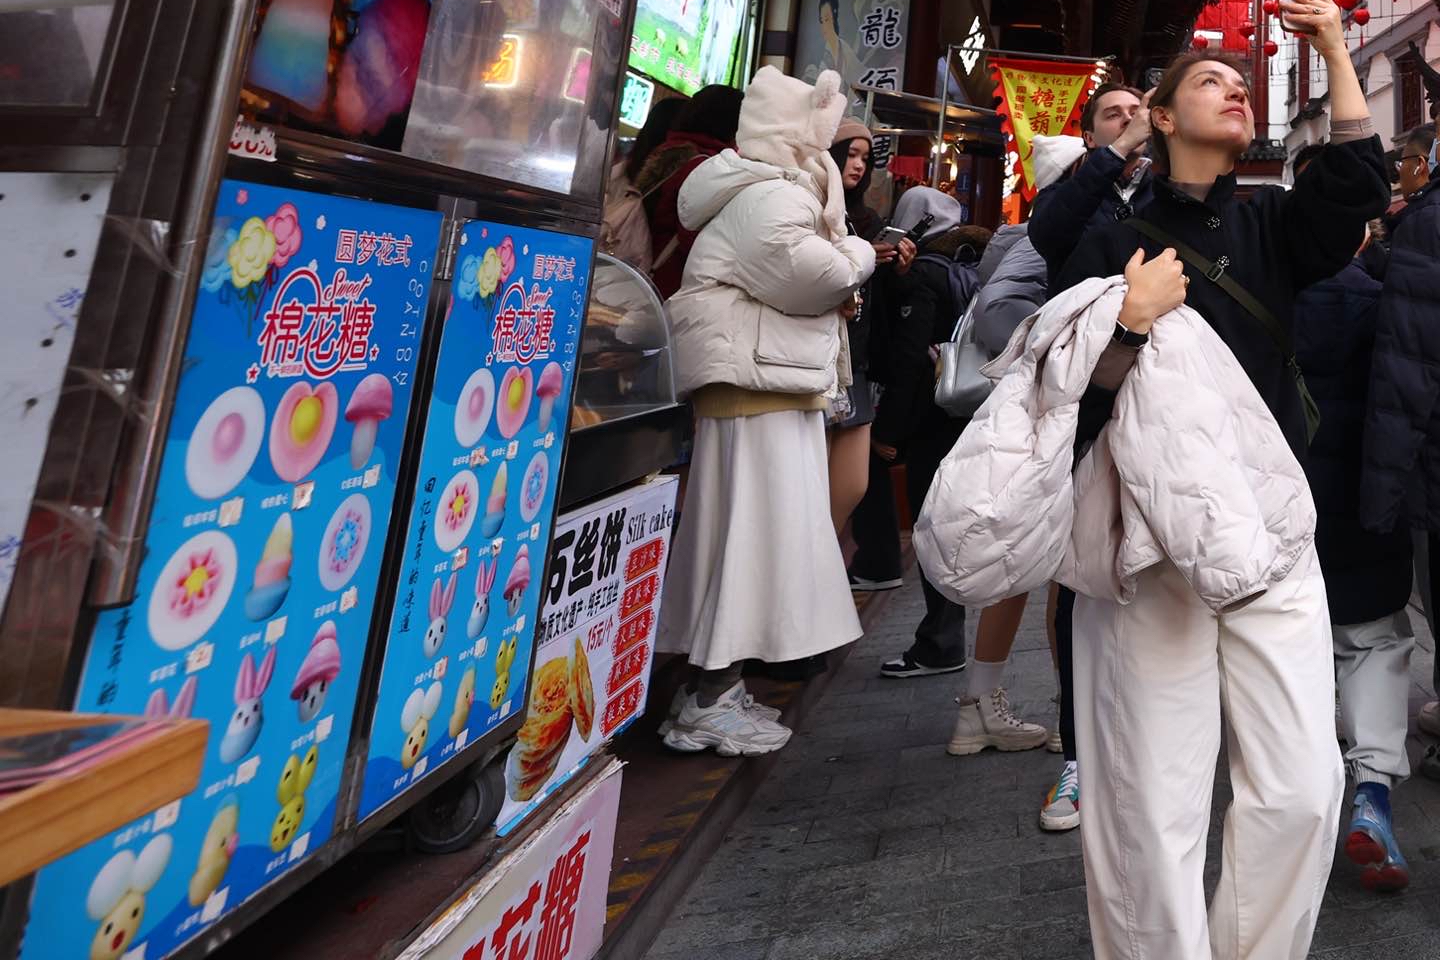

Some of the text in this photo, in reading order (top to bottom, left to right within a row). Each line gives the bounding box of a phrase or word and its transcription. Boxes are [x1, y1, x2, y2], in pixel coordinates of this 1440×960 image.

[335, 228, 413, 267] 圆梦花式
[323, 268, 373, 302] Sweet
[258, 298, 377, 368] 棉花糖
[492, 304, 556, 355] 棉花糖
[626, 504, 673, 545] Silk cake
